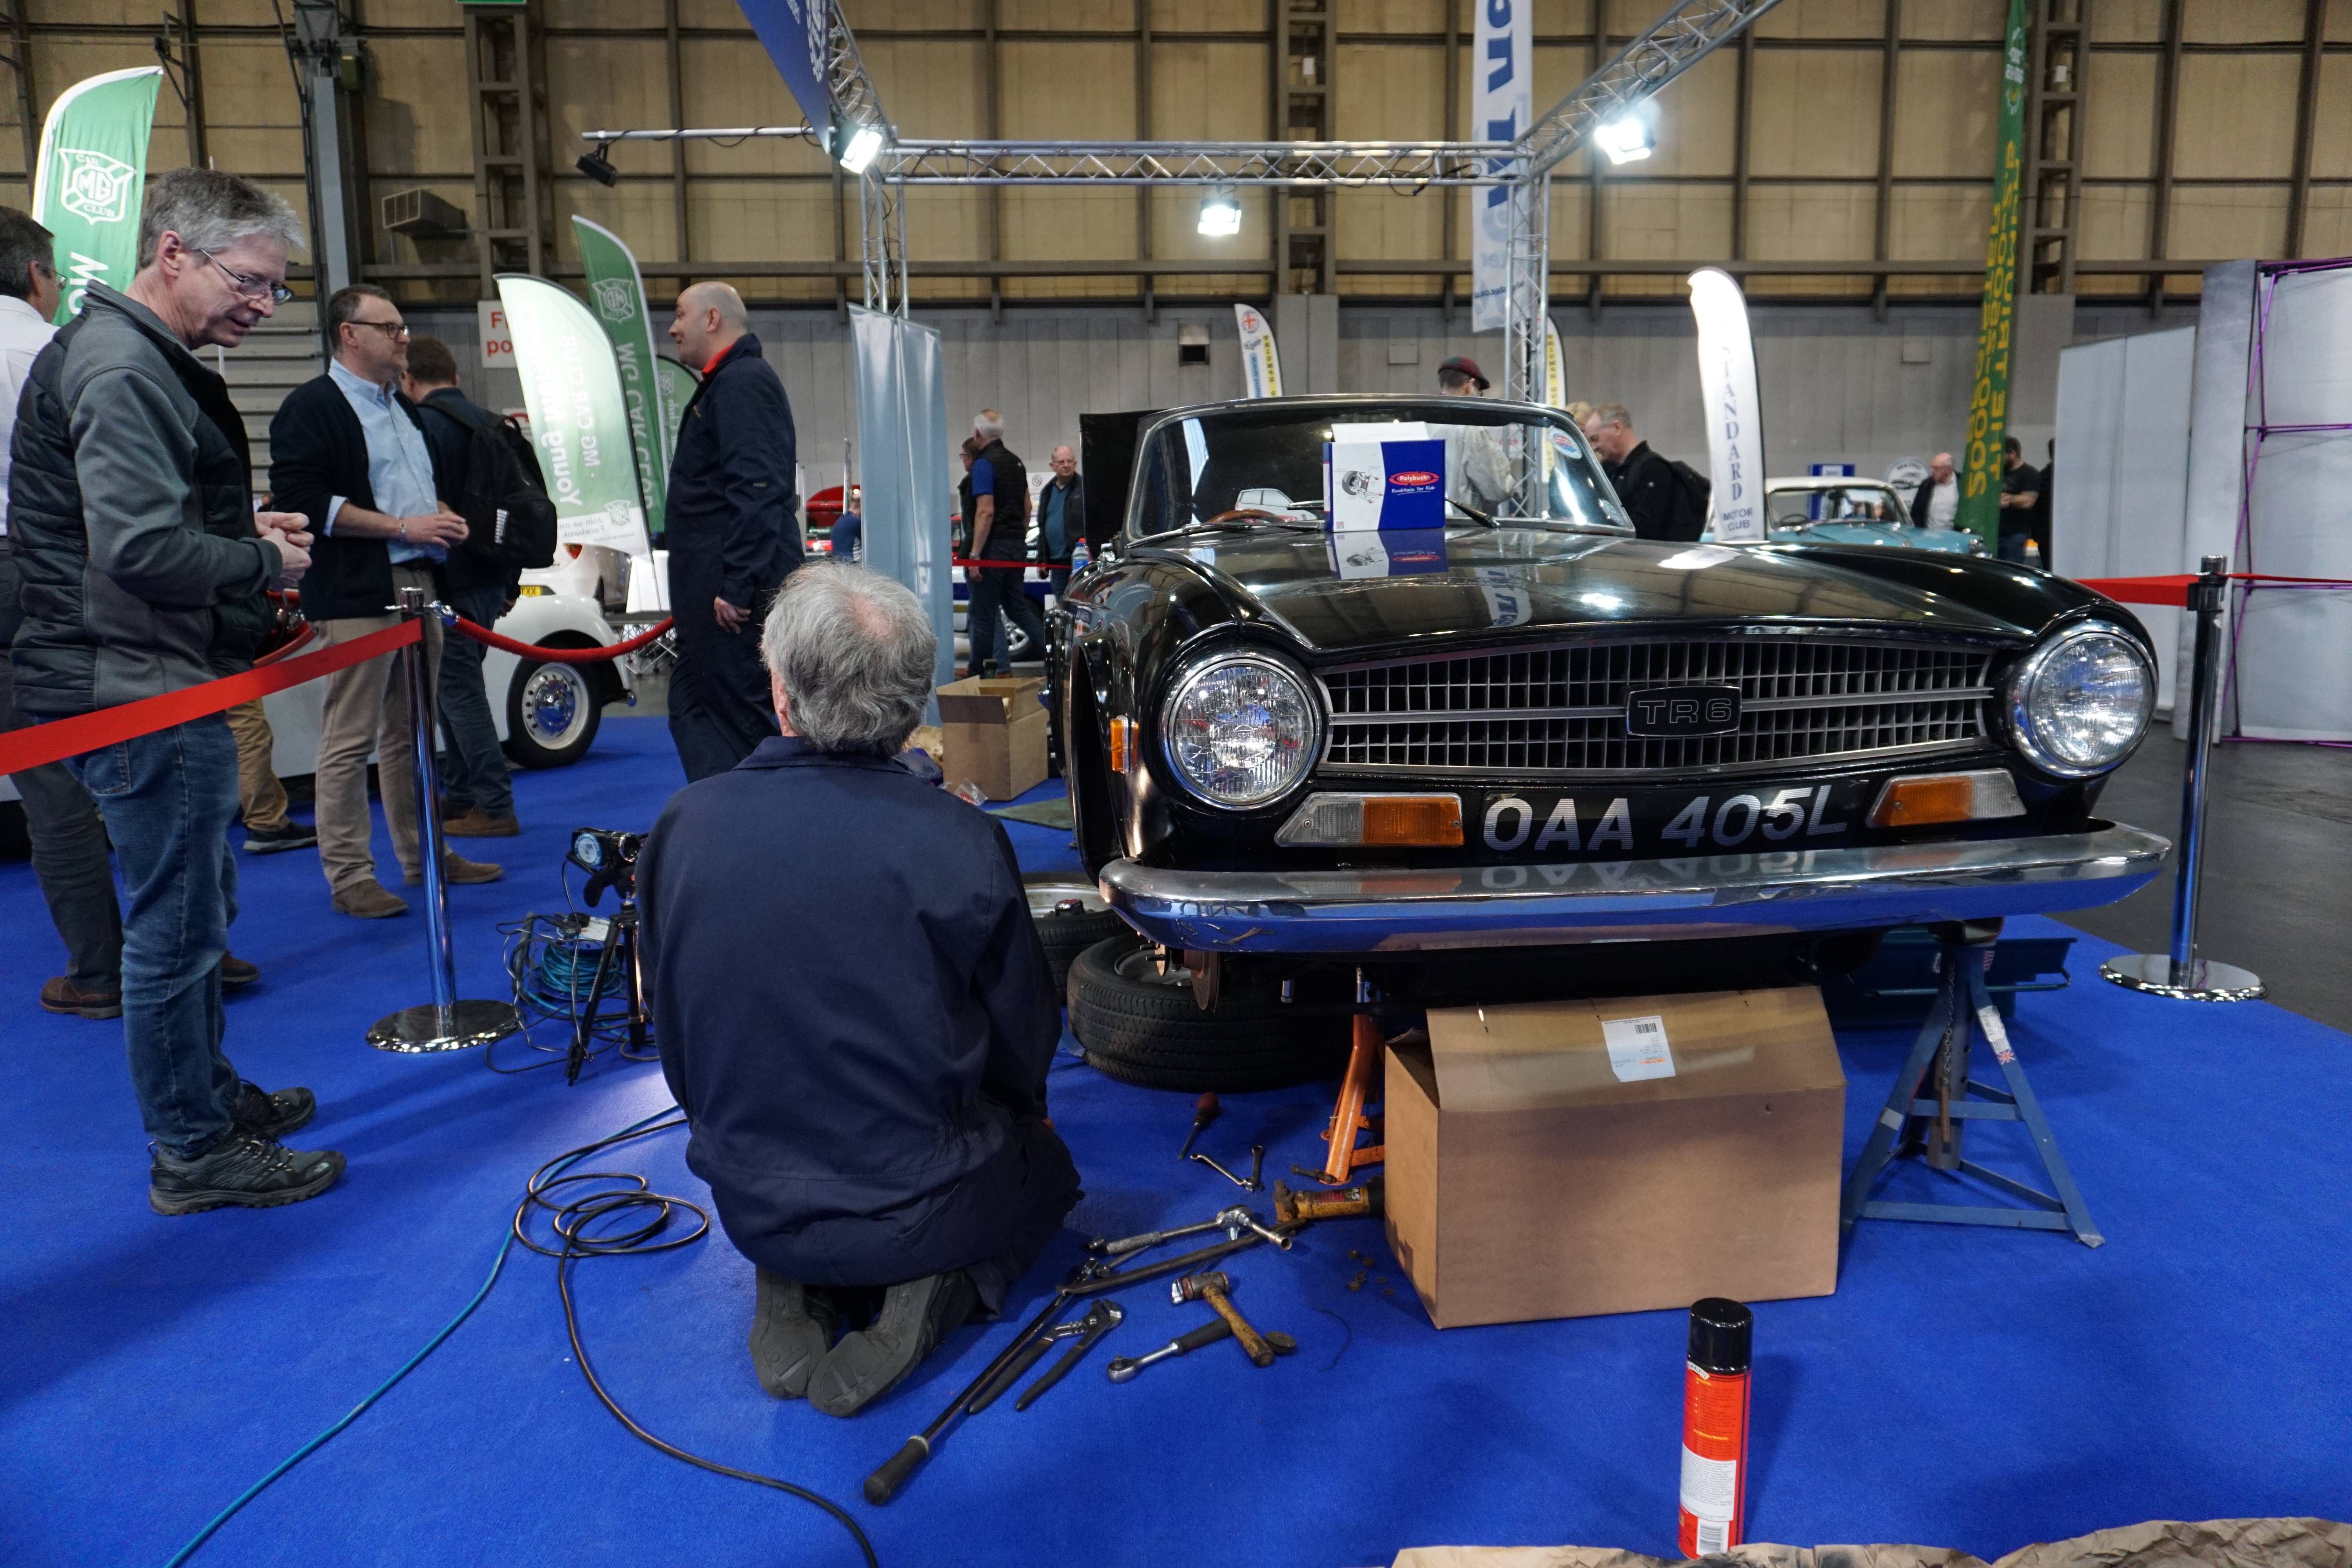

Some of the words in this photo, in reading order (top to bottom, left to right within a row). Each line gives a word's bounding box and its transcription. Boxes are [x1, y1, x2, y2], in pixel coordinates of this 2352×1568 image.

[75, 154, 99, 165] CAR
[79, 171, 112, 201] MG
[83, 205, 115, 218] CLUB
[1721, 345, 1742, 502] STANDARD
[1723, 508, 1753, 521] MOTOR
[1638, 698, 1731, 724] TR6
[1483, 797, 1634, 851] OAA
[1661, 785, 1848, 848] 405L
[1687, 1362, 1707, 1378] AMMERITE
